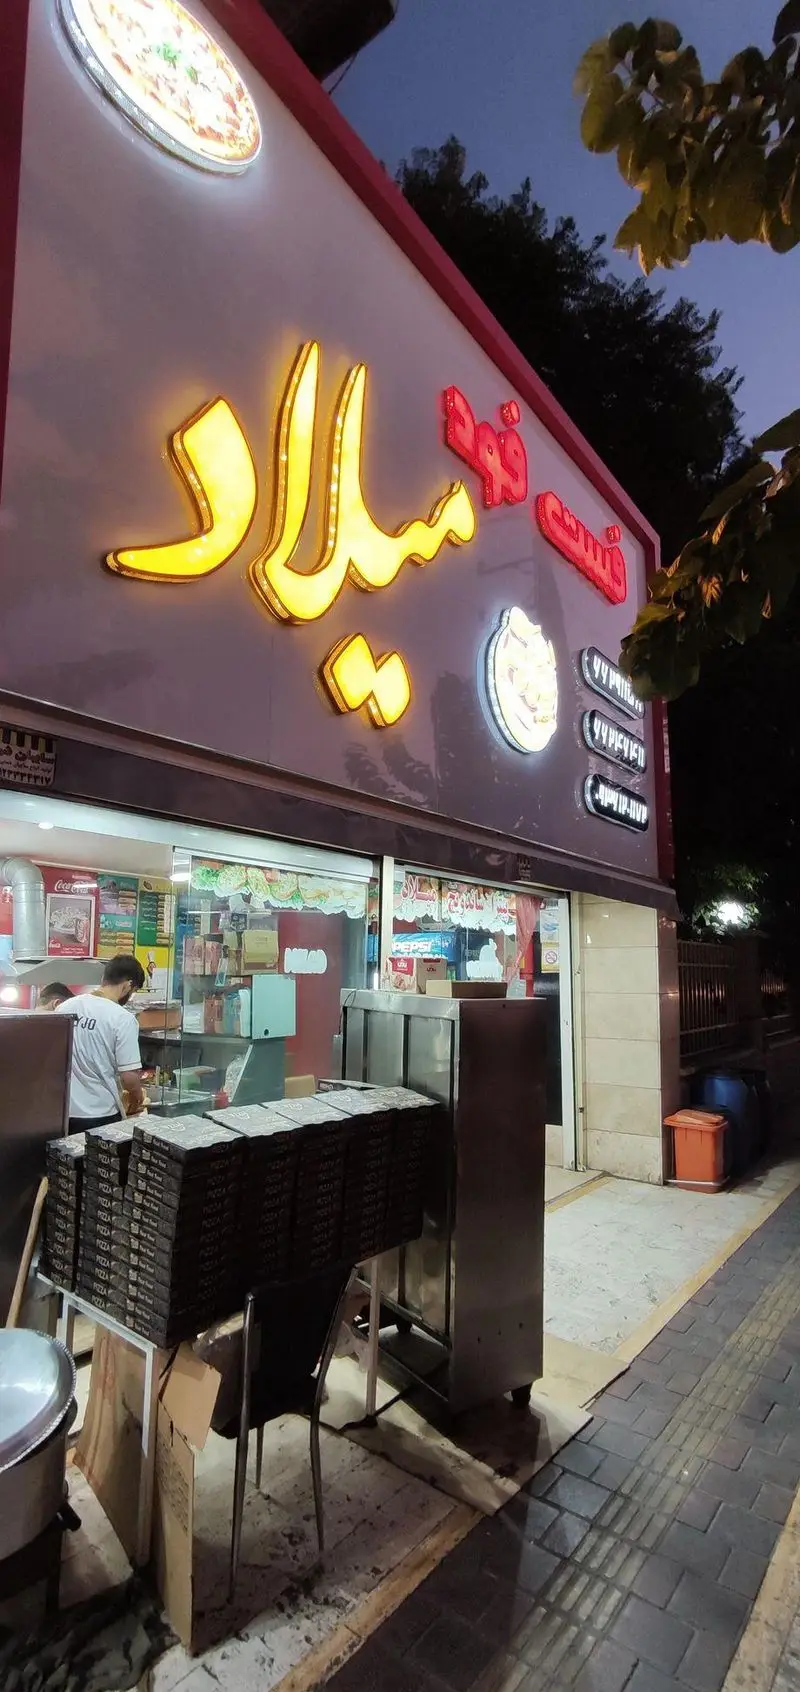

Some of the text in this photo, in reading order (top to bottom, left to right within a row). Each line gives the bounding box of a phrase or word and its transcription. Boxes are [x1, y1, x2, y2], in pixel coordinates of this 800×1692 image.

[105, 340, 478, 729] میلاد
[443, 384, 627, 605] فست فود
